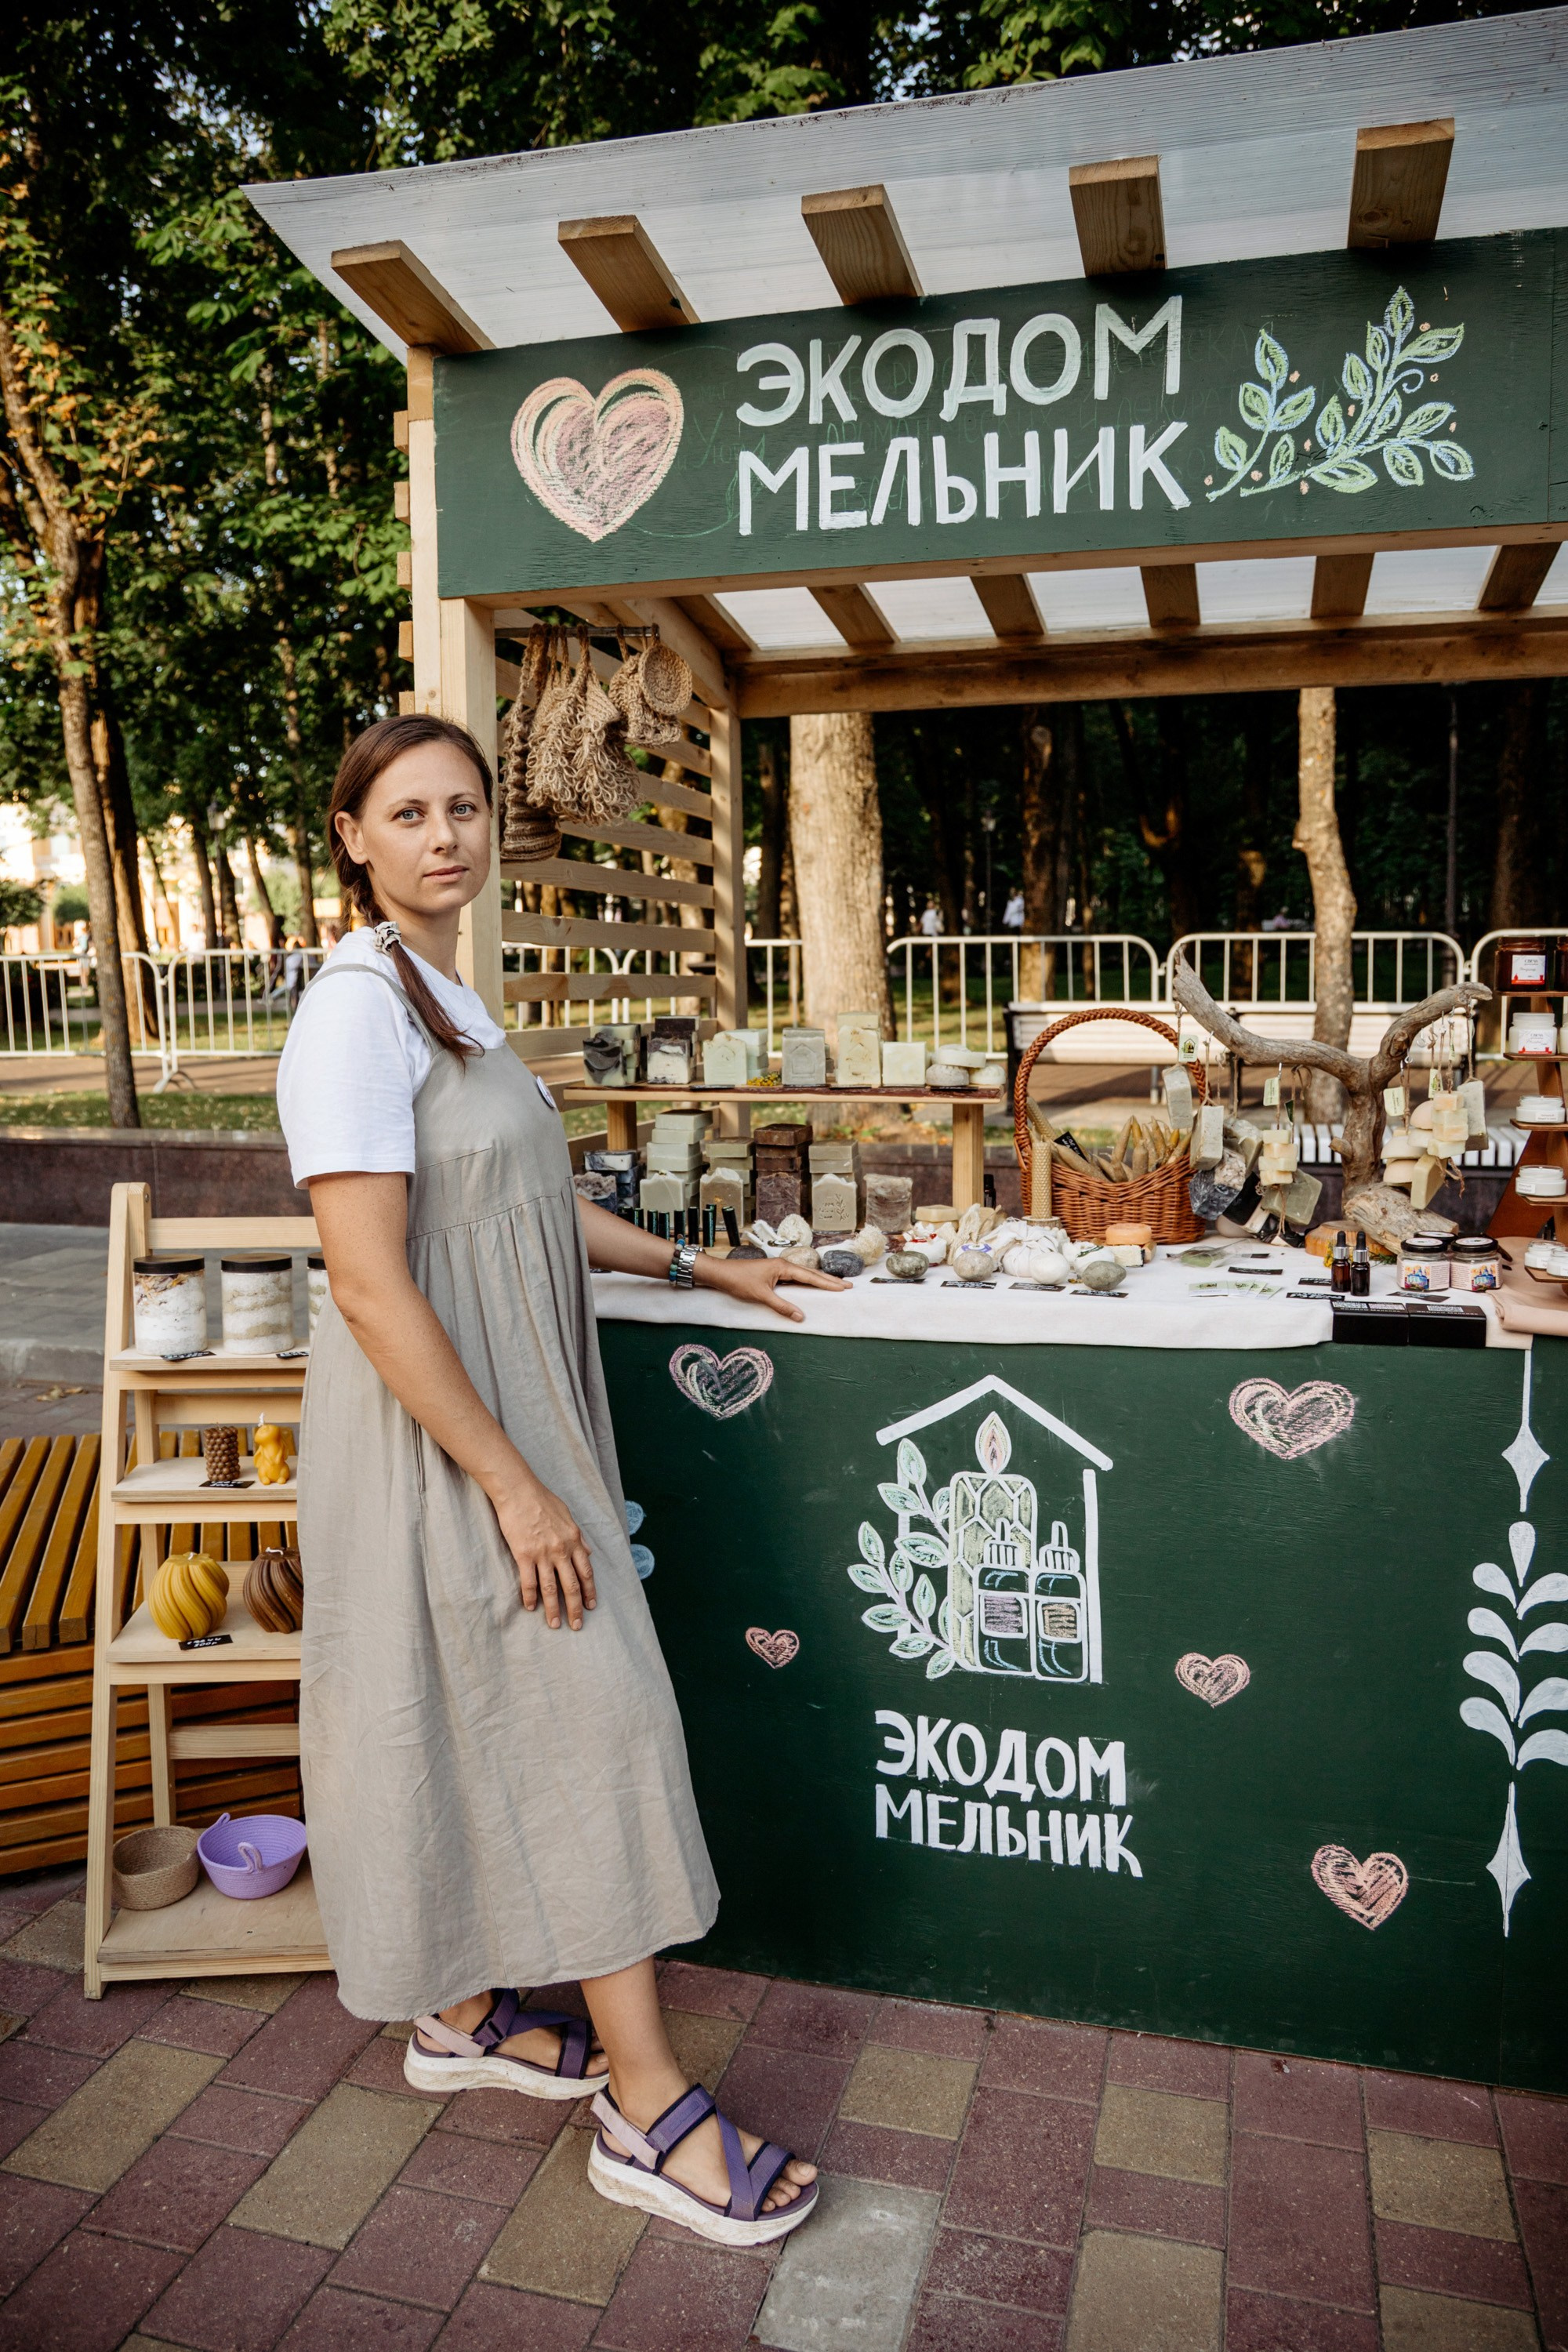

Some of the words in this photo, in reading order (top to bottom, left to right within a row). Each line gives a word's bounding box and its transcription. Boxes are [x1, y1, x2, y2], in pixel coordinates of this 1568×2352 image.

[737, 295, 1183, 426] ЭКОДОМ
[739, 422, 1190, 535] МЕЛЬНИК
[875, 1709, 1127, 1806] ЭКОДОМ
[875, 1784, 1144, 1878] МЕЛЬНИК
